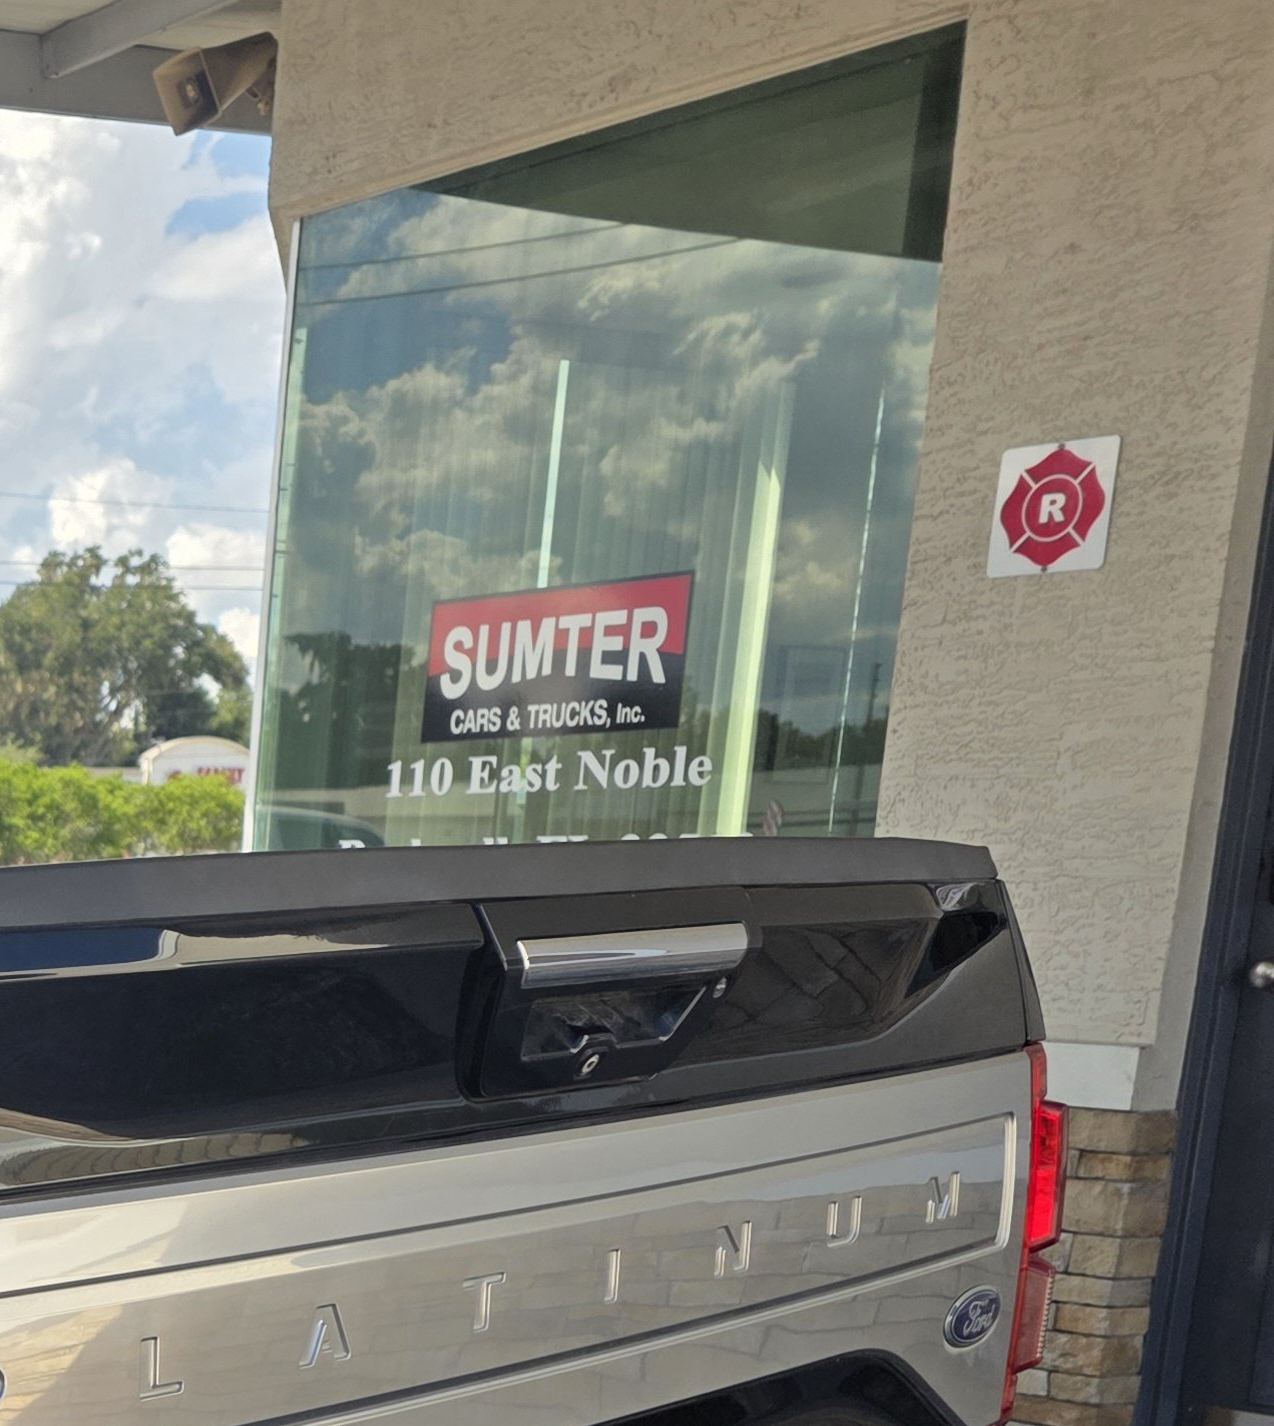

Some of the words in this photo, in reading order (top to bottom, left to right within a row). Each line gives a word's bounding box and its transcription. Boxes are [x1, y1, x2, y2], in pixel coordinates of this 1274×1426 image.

[1038, 492, 1066, 524] R
[439, 606, 668, 700] SUMTER
[450, 706, 501, 735] CARS
[507, 709, 521, 731] &
[527, 699, 611, 729] TRUCKS,
[616, 702, 646, 725] Inc.
[385, 757, 454, 798] 110
[466, 752, 562, 795] East
[573, 745, 713, 790] Noble
